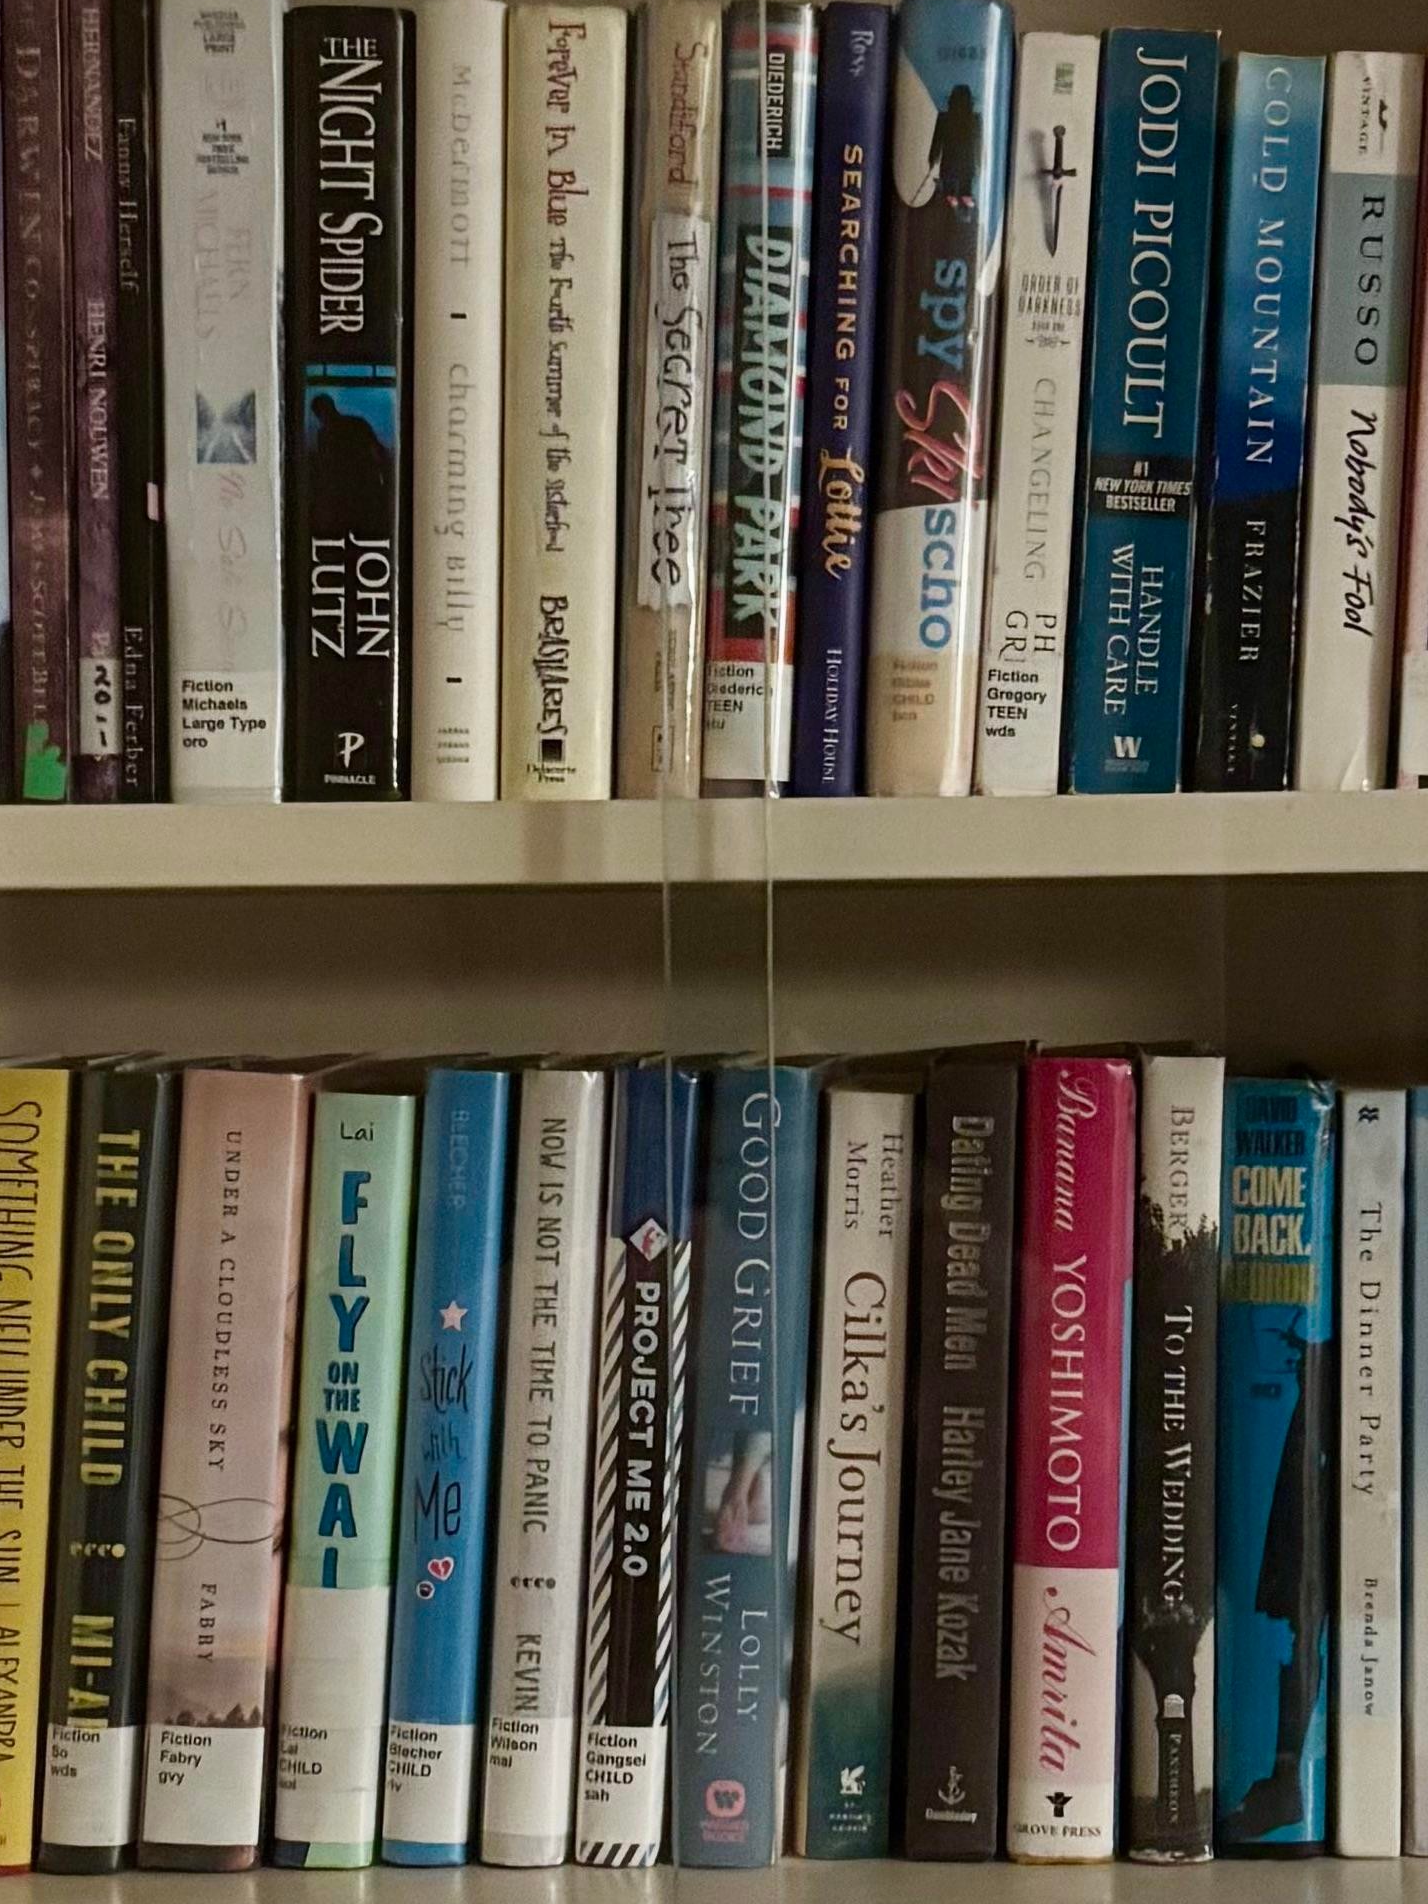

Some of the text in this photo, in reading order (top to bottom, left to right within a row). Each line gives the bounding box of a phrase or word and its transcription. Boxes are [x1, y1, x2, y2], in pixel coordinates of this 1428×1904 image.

[318, 54, 384, 335] NIGHT SPIDER
[1122, 45, 1189, 439] JODI PICOULT
[1352, 194, 1388, 367] RUSSO
[1104, 494, 1177, 513] BESTSELLER
[309, 536, 348, 659] LUTZ
[351, 530, 391, 658] JOHN
[1102, 541, 1136, 715] WITH CARE
[1132, 564, 1164, 695] HANDLE
[182, 697, 250, 712] Michaels
[183, 679, 235, 693] Fiction
[939, 1113, 996, 1372] Dating Dead Men
[1229, 1164, 1310, 1209] COME
[77, 1128, 142, 1487] THE ONLY CHILD
[620, 1280, 662, 1579] PROJECT ME 2.0
[818, 1270, 888, 1647] Cilka's Journey
[1036, 1064, 1100, 1774] Banana YOSHIMOTO Amrita
[158, 1731, 214, 1748] Fiction
[158, 1750, 208, 1766] Fabry
